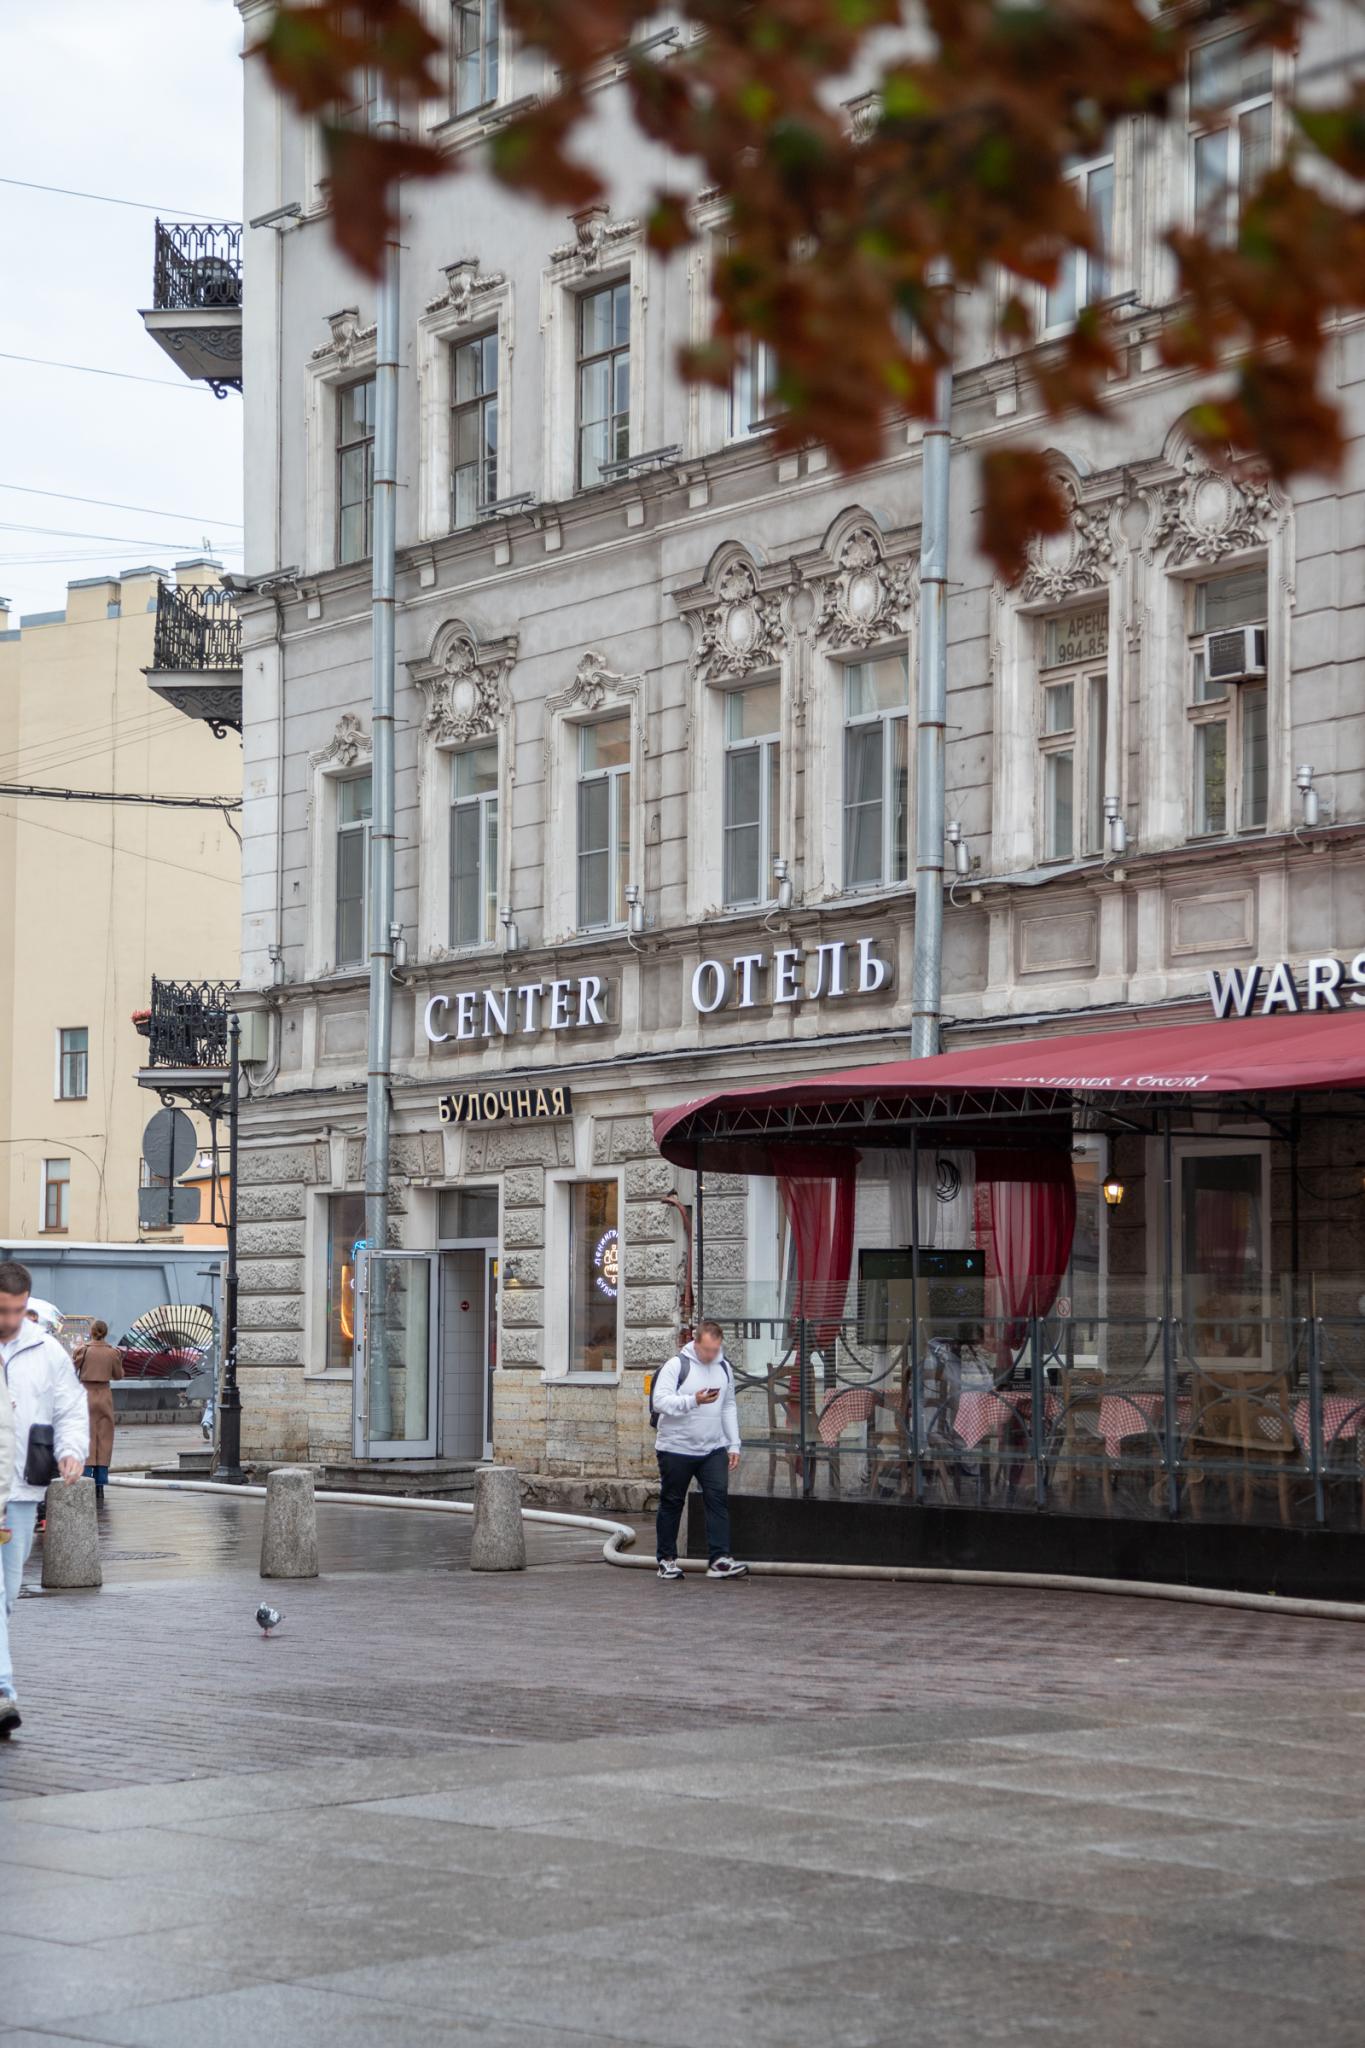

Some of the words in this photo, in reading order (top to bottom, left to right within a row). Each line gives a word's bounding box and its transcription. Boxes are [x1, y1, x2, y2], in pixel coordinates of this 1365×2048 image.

[691, 937, 885, 1013] ОТЕЛЬ
[424, 976, 604, 1043] CENTER
[438, 1087, 566, 1123] БУЛОЧНАЯ
